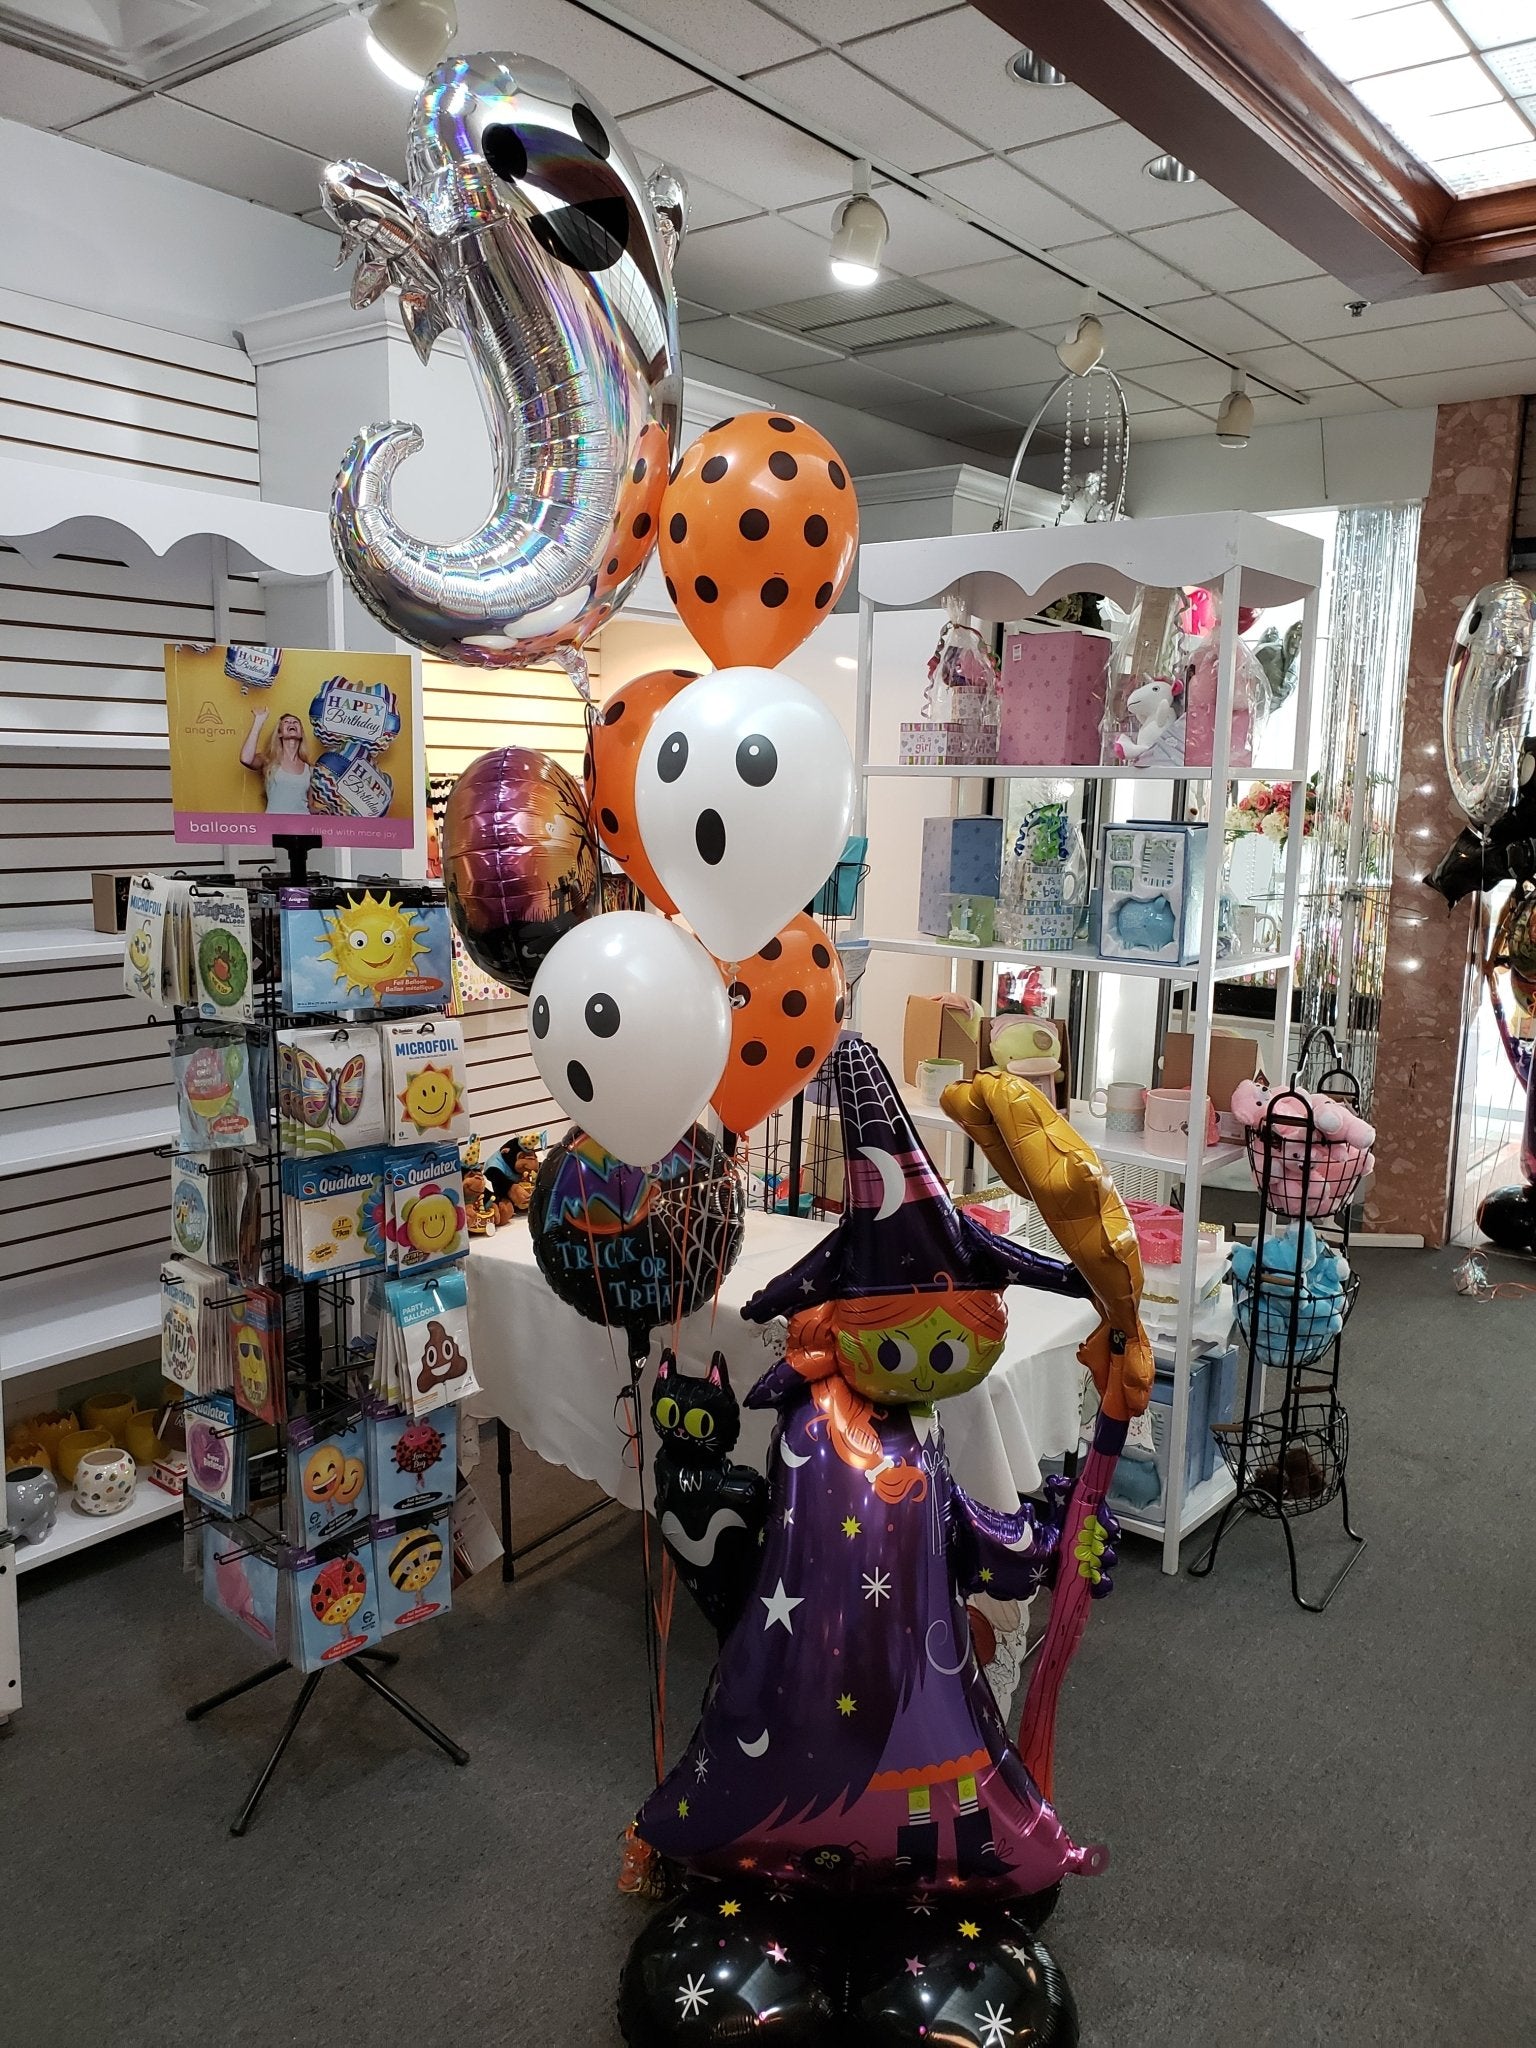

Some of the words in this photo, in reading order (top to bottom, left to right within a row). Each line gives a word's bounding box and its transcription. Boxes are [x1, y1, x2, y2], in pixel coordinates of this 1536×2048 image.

[236, 658, 269, 676] Birthday
[238, 650, 272, 668] HAPPY
[328, 696, 384, 717] HAPPY
[185, 727, 236, 738] anagram
[325, 708, 382, 736] Birthday
[915, 742, 932, 754] girl
[352, 764, 390, 804] HAPPY
[343, 774, 380, 816] Birthday
[190, 821, 256, 834] balloons
[311, 826, 333, 836] filled
[336, 828, 355, 837] with
[358, 830, 380, 838] more
[384, 830, 397, 839] joy
[1042, 886, 1060, 899] boy
[130, 894, 162, 916] MICROFOIL
[1040, 926, 1057, 936] boy
[395, 1038, 458, 1056] MICROFOIL
[319, 1172, 374, 1194] Qualatex
[408, 1161, 458, 1185] Qualatex
[556, 1237, 639, 1270] TRICK
[641, 1256, 670, 1278] OR
[163, 1284, 196, 1309] MICROFOIL
[609, 1280, 690, 1310] TREAT
[402, 1302, 424, 1315] PARTY
[404, 1306, 435, 1323] BALLOON
